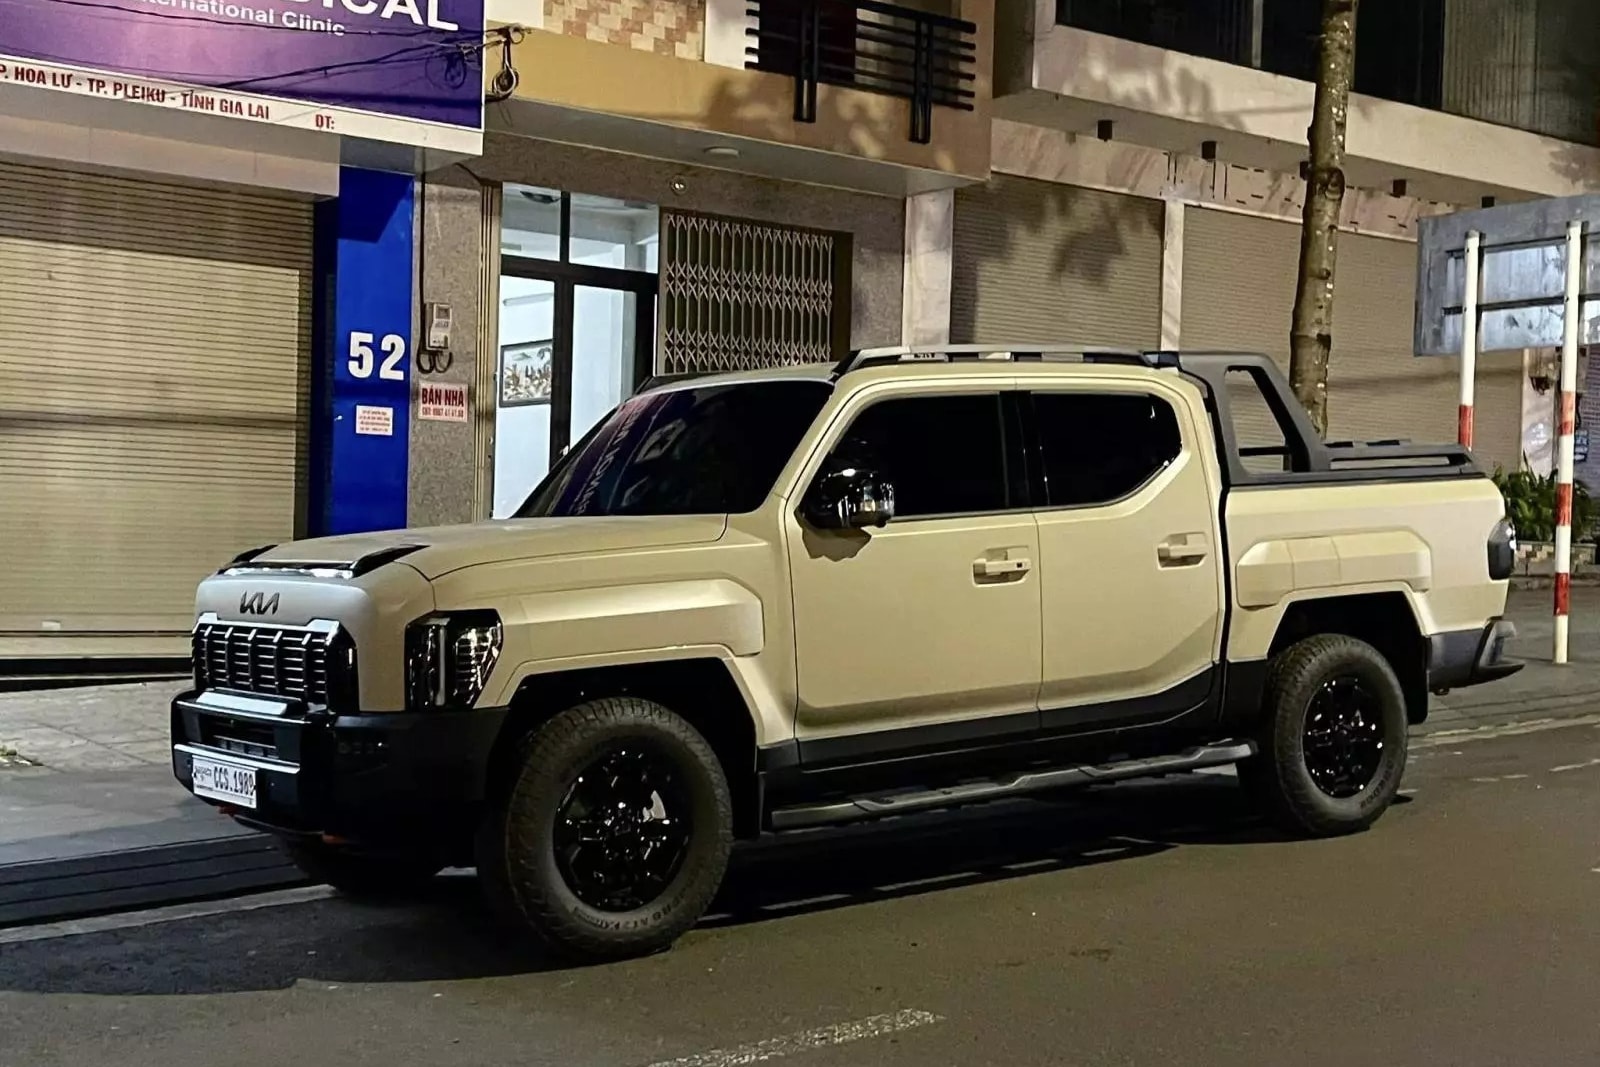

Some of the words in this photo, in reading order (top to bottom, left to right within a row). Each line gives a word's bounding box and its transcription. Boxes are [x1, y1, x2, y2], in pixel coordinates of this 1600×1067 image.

[281, 11, 345, 36] Clinic
[14, 66, 47, 85] HOA
[52, 72, 73, 88] LƯ
[87, 77, 108, 95] TP.
[113, 81, 166, 103] PLEIKU
[219, 98, 243, 116] GIA
[247, 103, 270, 120] LAI
[348, 331, 406, 381] 52
[421, 384, 442, 406] BÁN
